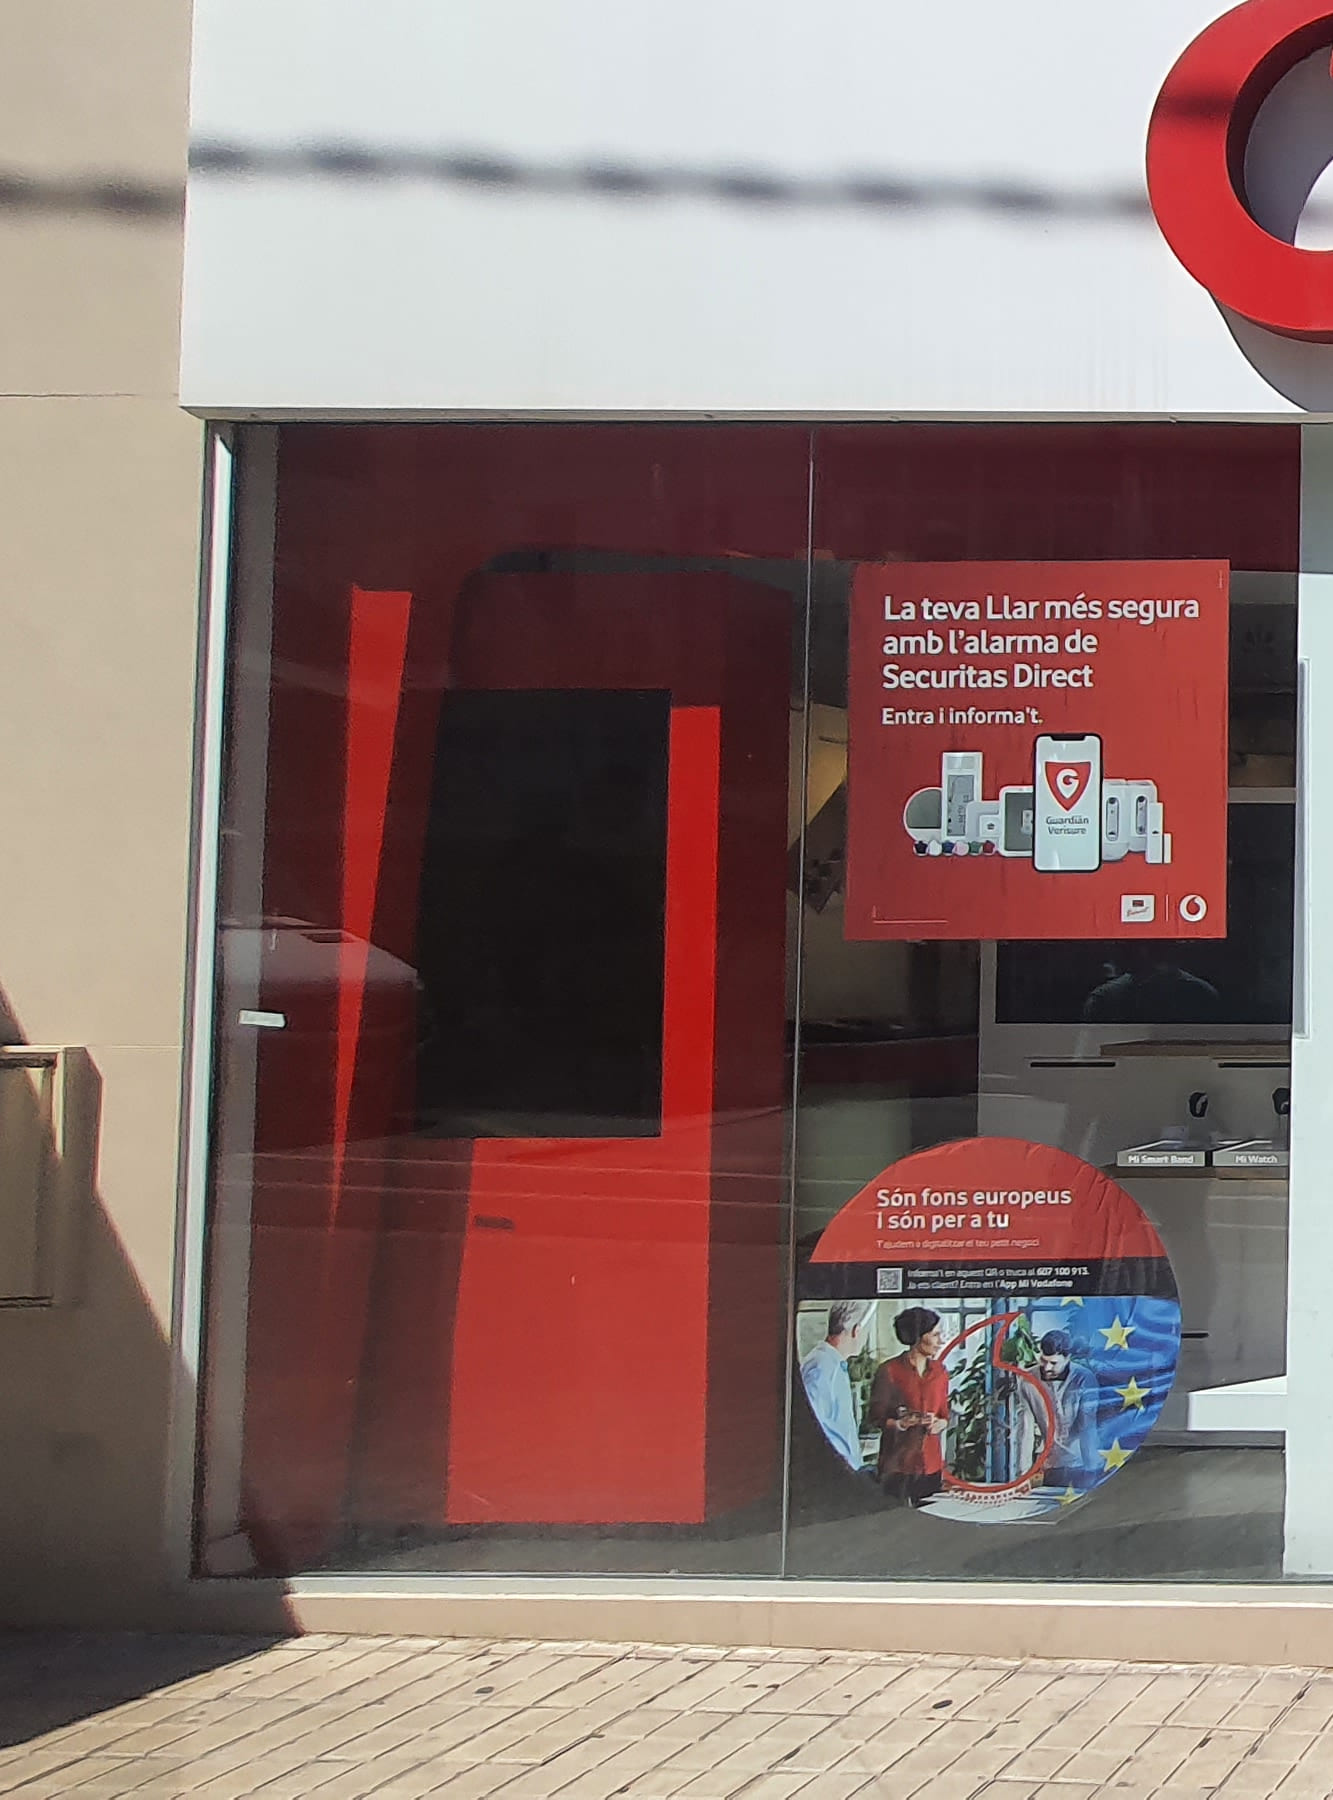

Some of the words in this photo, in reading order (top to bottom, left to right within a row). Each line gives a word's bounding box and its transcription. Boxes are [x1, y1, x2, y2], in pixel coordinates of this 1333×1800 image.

[885, 596, 915, 621] La
[921, 598, 980, 621] teva
[986, 596, 1040, 620] Llar
[1045, 592, 1102, 620] més
[1107, 597, 1200, 625] segura
[882, 630, 944, 655] amb
[949, 629, 1059, 655] l'alarma
[1064, 628, 1098, 654] de
[882, 663, 1008, 690] Securitas
[1013, 663, 1094, 688] Direct
[881, 708, 935, 725] Entra
[938, 707, 945, 724] i
[949, 707, 1043, 724] informa't.
[1128, 1154, 1139, 1164] Mi
[1141, 1154, 1169, 1164] Smart
[1171, 1154, 1194, 1164] Band
[1248, 1154, 1278, 1164] Watch
[876, 1189, 917, 1208] Són
[921, 1188, 969, 1206] fons
[972, 1189, 1073, 1209] europeus
[888, 1210, 926, 1229] són
[931, 1213, 965, 1232] per
[970, 1214, 982, 1228] a
[987, 1211, 1010, 1228] tu
[1031, 1279, 1073, 1288] Vodafone
